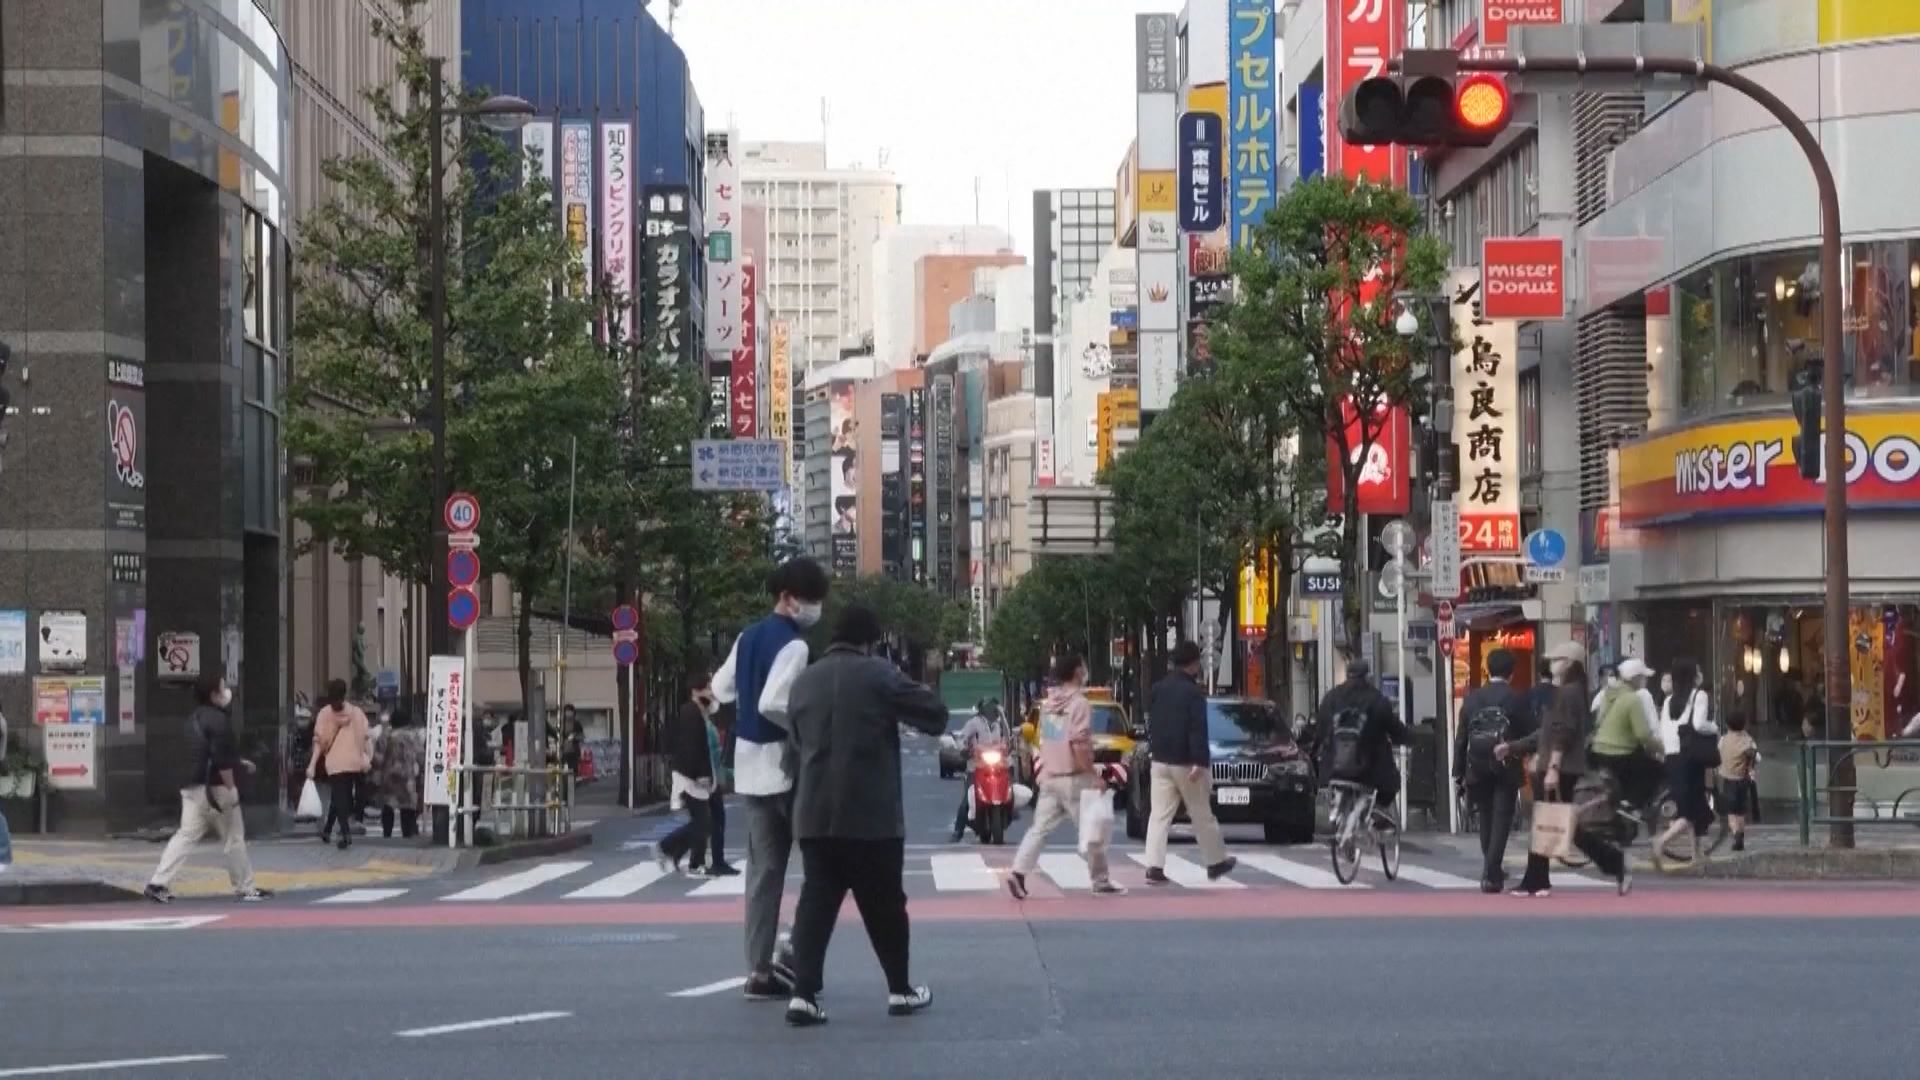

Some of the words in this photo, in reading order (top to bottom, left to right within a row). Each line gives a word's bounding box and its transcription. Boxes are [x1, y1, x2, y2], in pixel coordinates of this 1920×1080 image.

[1487, 6, 1557, 20] Donut
[1236, 0, 1271, 255] プセルホテル
[1488, 279, 1557, 294] Donut
[454, 505, 471, 522] 40
